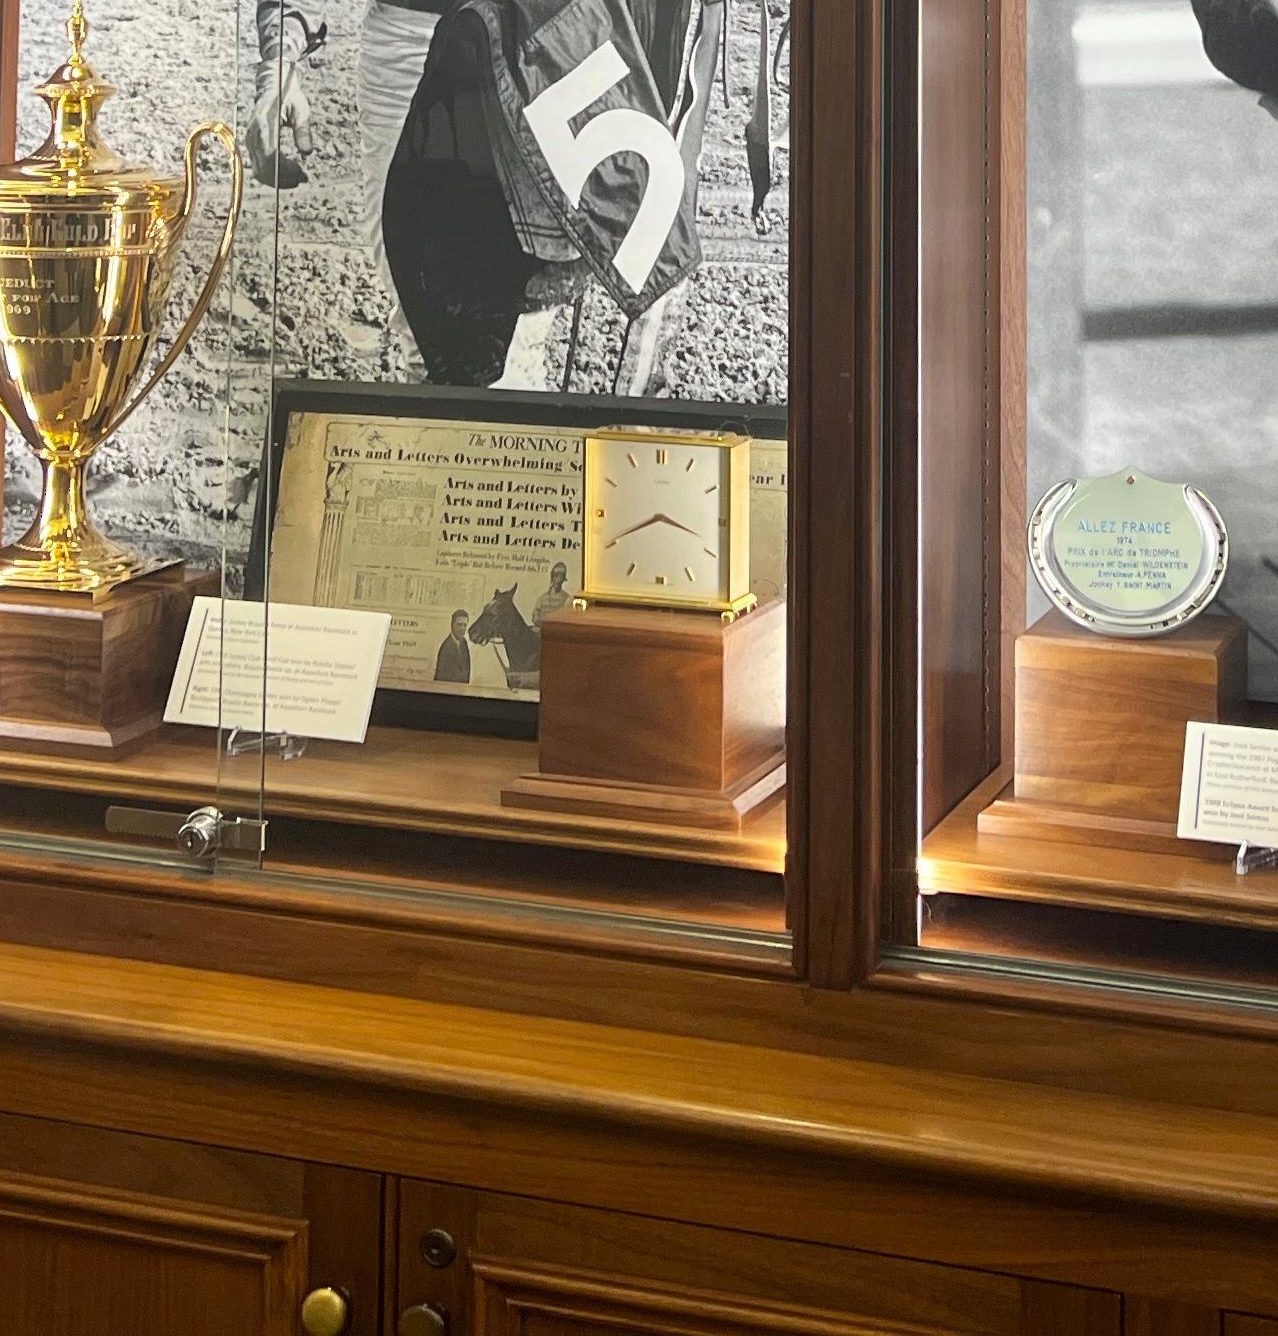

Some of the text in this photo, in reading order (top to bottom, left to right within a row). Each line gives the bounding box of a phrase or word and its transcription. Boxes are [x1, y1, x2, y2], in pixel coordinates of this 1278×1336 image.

[522, 38, 686, 297] 5
[468, 433, 487, 447] The
[489, 435, 568, 454] MORNING
[329, 445, 563, 473] Arts and Letters Overwhelming
[444, 477, 579, 496] Arts and Letters by
[442, 494, 473, 506] Arts
[475, 498, 502, 509] and
[506, 498, 557, 512] Letters
[440, 512, 471, 524] Arts
[477, 515, 504, 527] and
[510, 516, 565, 531] Letters
[1078, 520, 1172, 535] ALLEZ FRANCE
[438, 530, 469, 542] Arts
[473, 534, 499, 545] and
[505, 534, 556, 549] Letters
[1116, 537, 1132, 545] 1974
[1067, 547, 1085, 556] PRIX
[1140, 547, 1180, 557] TRIOMPHE
[1146, 582, 1172, 590] MARTIN
